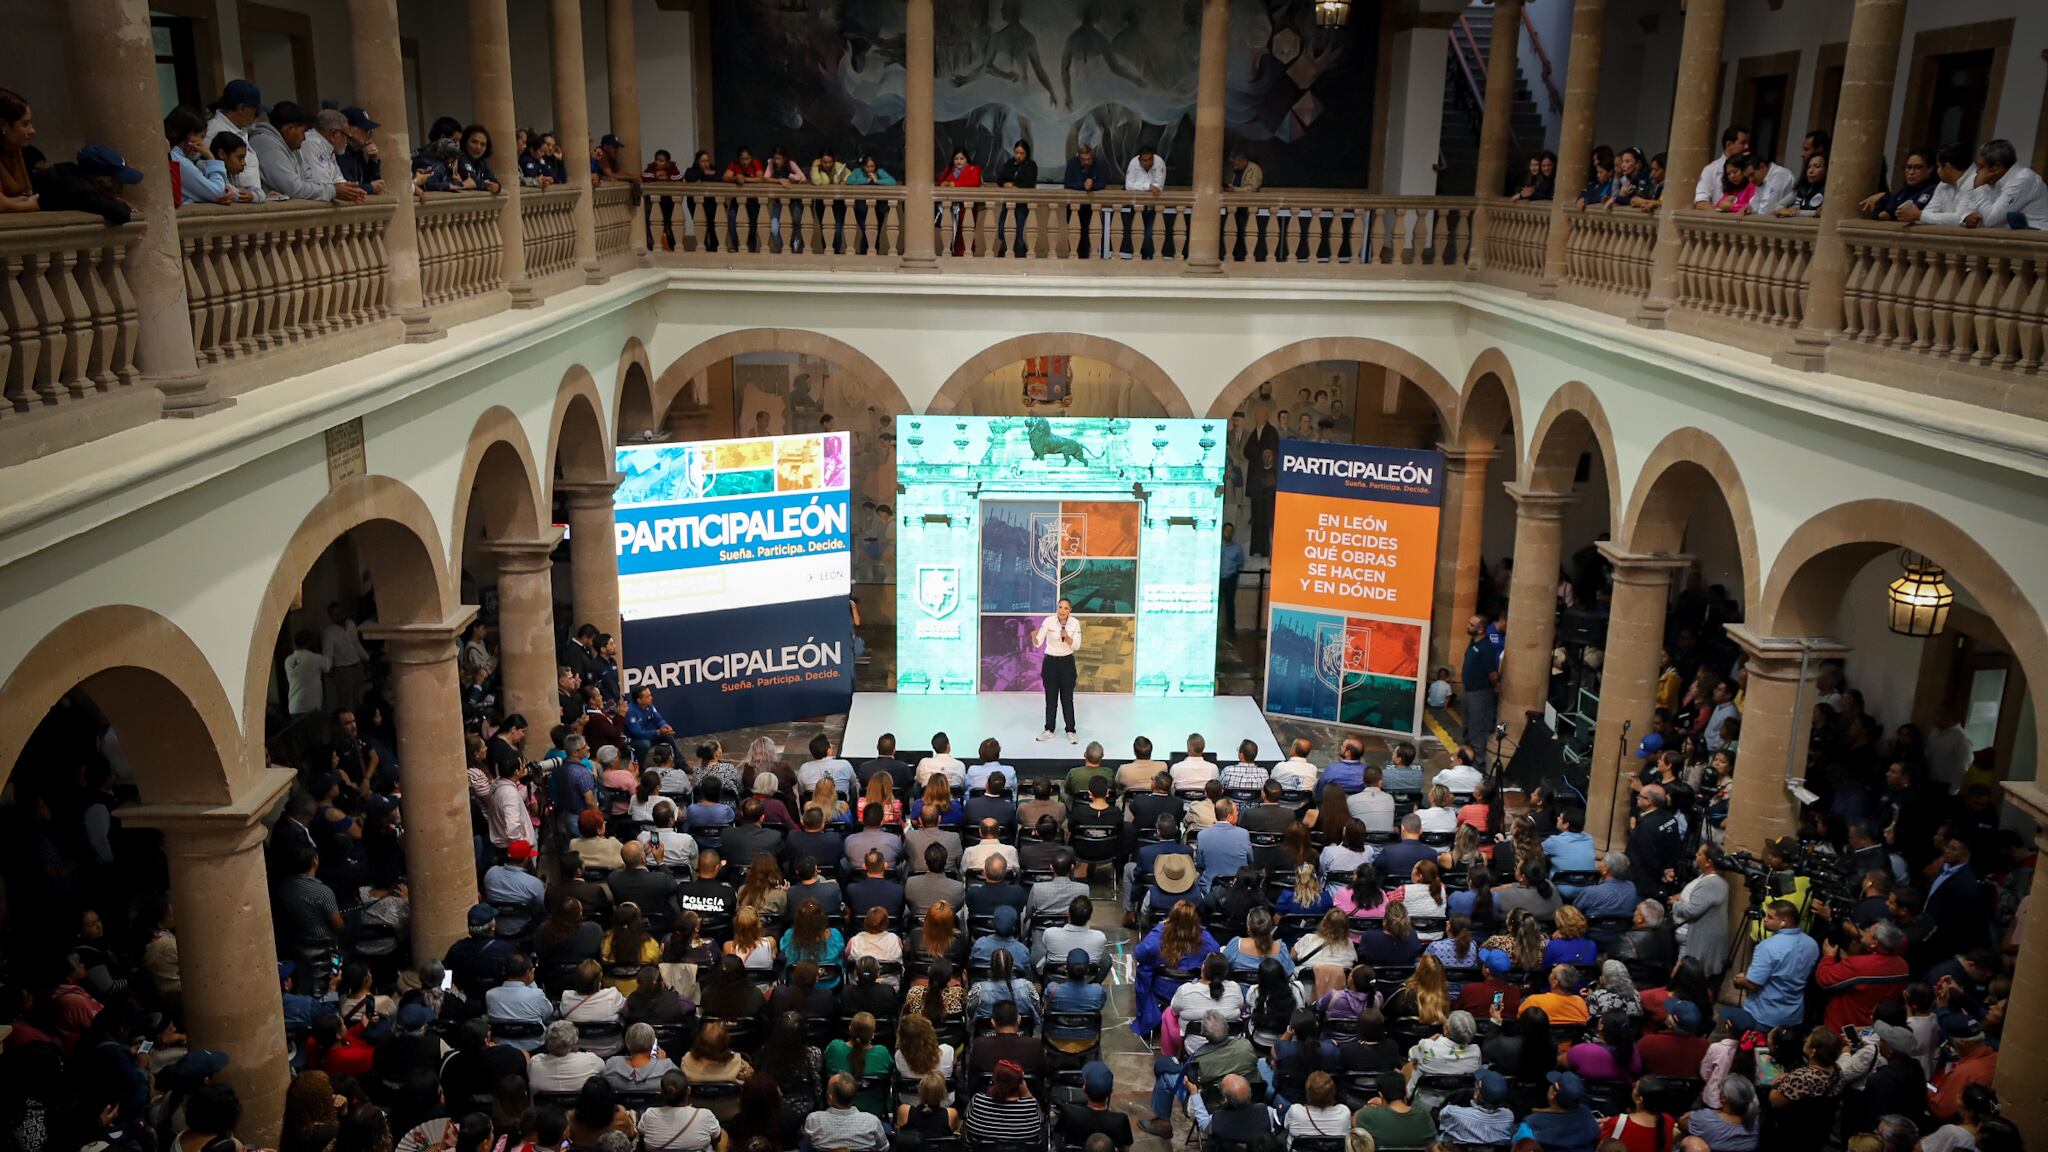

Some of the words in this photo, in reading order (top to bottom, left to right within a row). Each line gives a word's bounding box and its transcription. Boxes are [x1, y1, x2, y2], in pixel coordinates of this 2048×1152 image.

[1282, 455, 1433, 485] PARTICIPALEÓN
[1344, 479, 1368, 488] Sueña.
[1369, 481, 1402, 491] Participa.
[1403, 484, 1431, 494] Decide.
[615, 496, 847, 555] PARTICIPALEÓN
[1318, 513, 1340, 527] EN
[1343, 515, 1388, 532] LEÓN
[719, 549, 754, 562] Sueña.
[757, 542, 806, 558] Participa.
[808, 538, 846, 552] Decide.
[1305, 527, 1326, 543] TÚ
[1329, 531, 1398, 551] DECIDES
[1304, 545, 1338, 561] QUÉ
[1341, 549, 1397, 568] OBRAS
[1308, 562, 1327, 577] SE
[1330, 565, 1386, 583] HACEN
[1300, 578, 1311, 591] Y
[1314, 580, 1335, 594] EN
[1339, 582, 1398, 601] DÓNDE
[623, 636, 841, 694] PARTICIPALEÓN
[721, 680, 755, 692] Sueña.
[757, 673, 803, 687] Participa.
[805, 669, 841, 681] Decide.
[682, 894, 725, 906] POLICÍA
[682, 902, 725, 912] MUNICIPAL
